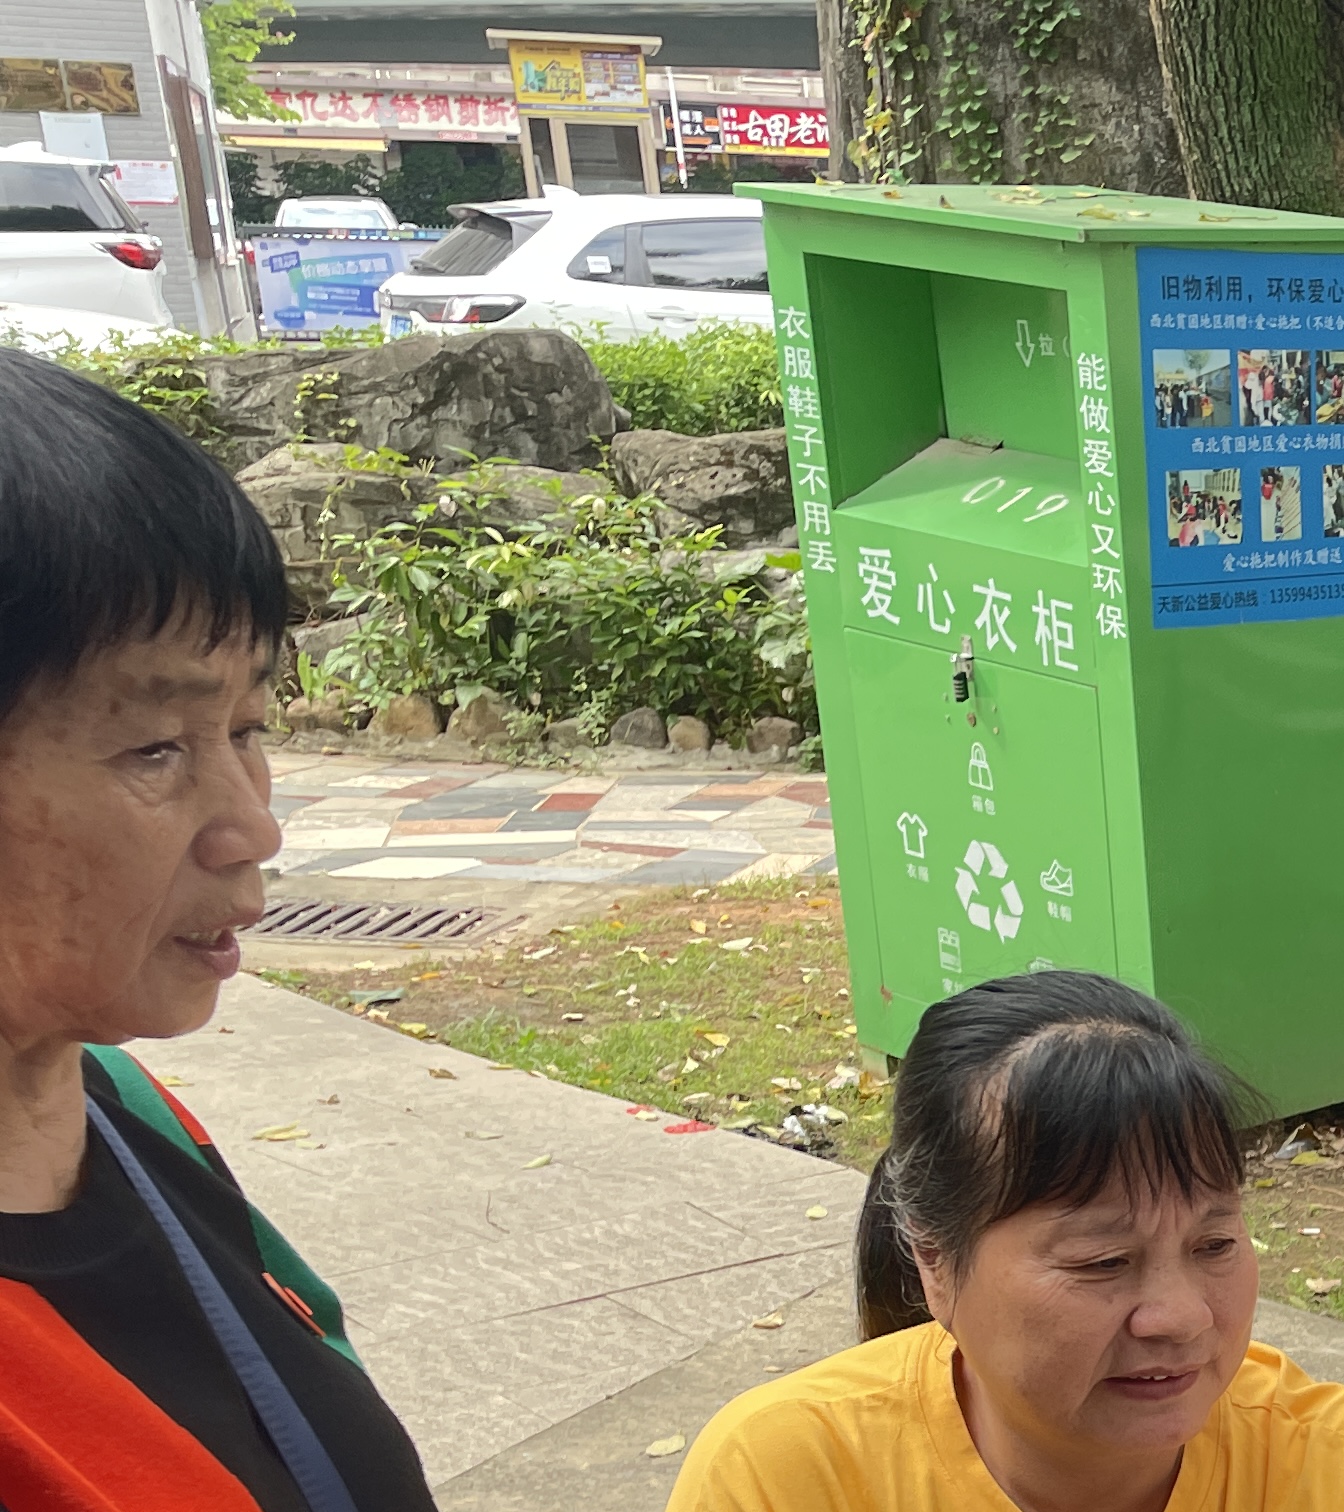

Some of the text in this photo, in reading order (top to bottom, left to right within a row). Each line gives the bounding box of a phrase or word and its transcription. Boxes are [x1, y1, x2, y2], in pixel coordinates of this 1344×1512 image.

[265, 87, 517, 126] 亿达不锈钢剪折
[778, 306, 837, 574] 衣服鞋子不用丢
[961, 476, 1069, 523] 019
[1076, 352, 1127, 640] 能做爱心又环保
[858, 546, 1078, 672] 爱心衣柜
